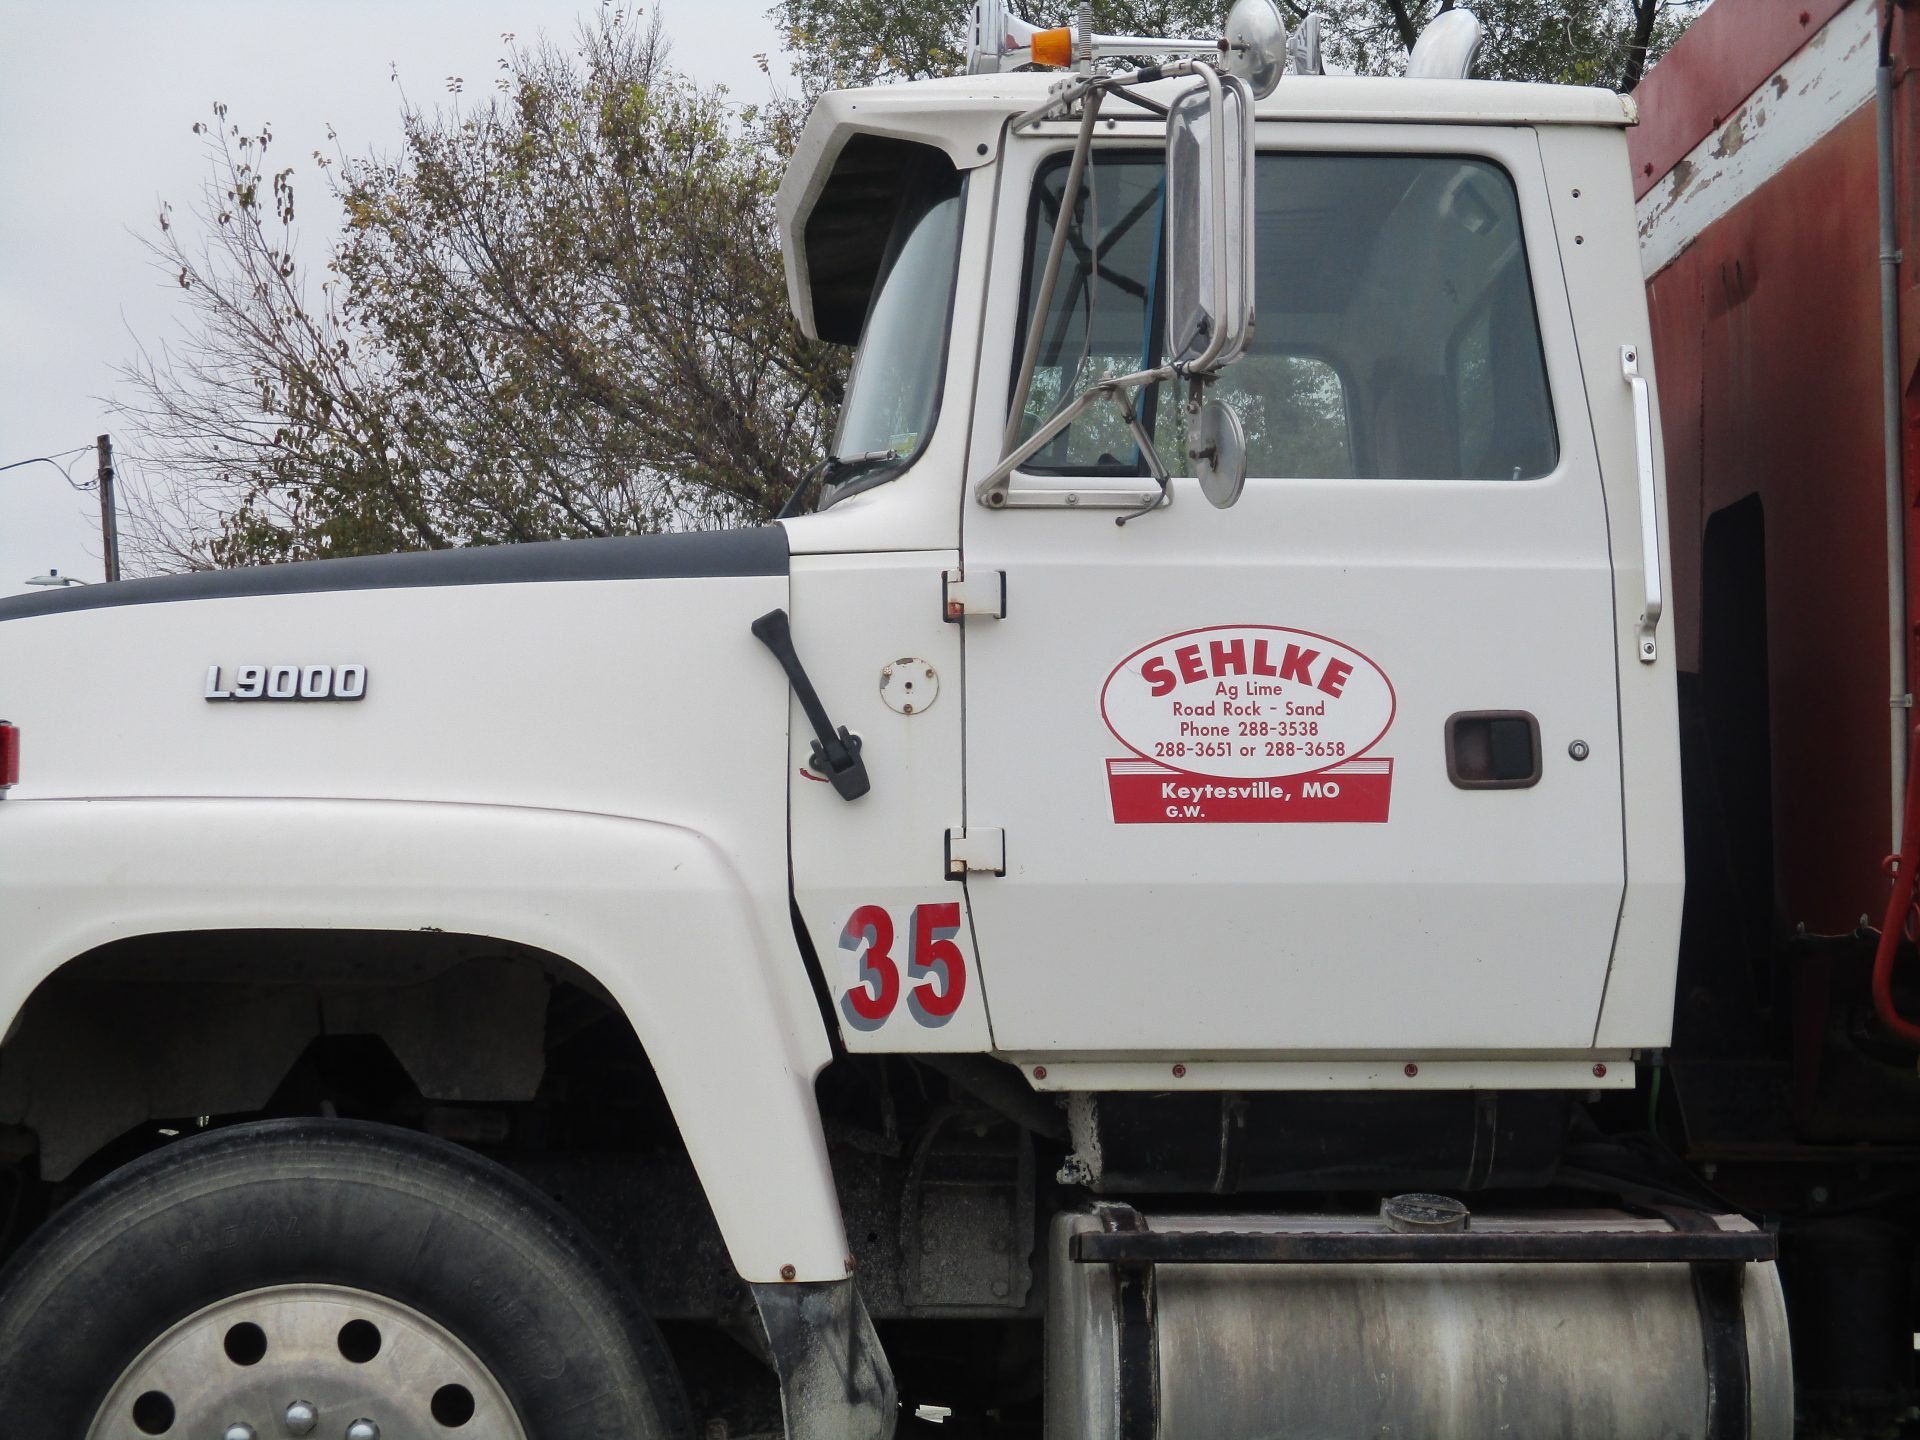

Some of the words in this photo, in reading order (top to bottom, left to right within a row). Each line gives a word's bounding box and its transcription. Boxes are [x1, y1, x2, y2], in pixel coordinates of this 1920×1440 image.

[1141, 639, 1353, 698] SEHLKE
[204, 664, 367, 702] L9000
[1215, 682, 1238, 699] Ag
[1247, 682, 1282, 696] Lime
[1173, 702, 1215, 716] Road
[1224, 702, 1261, 716] Rock
[1286, 702, 1324, 716] Sand
[1180, 722, 1229, 736] Phone
[1239, 722, 1318, 736] 288-3538
[1155, 742, 1232, 757] 288-3651
[1240, 746, 1256, 757] or
[1265, 742, 1345, 757] 288-3658
[1162, 782, 1292, 802] Keytesville,
[1303, 782, 1340, 798] MO
[1166, 806, 1205, 817] G.W.
[838, 902, 966, 1031] 35
[175, 1216, 303, 1265] RADIAL
